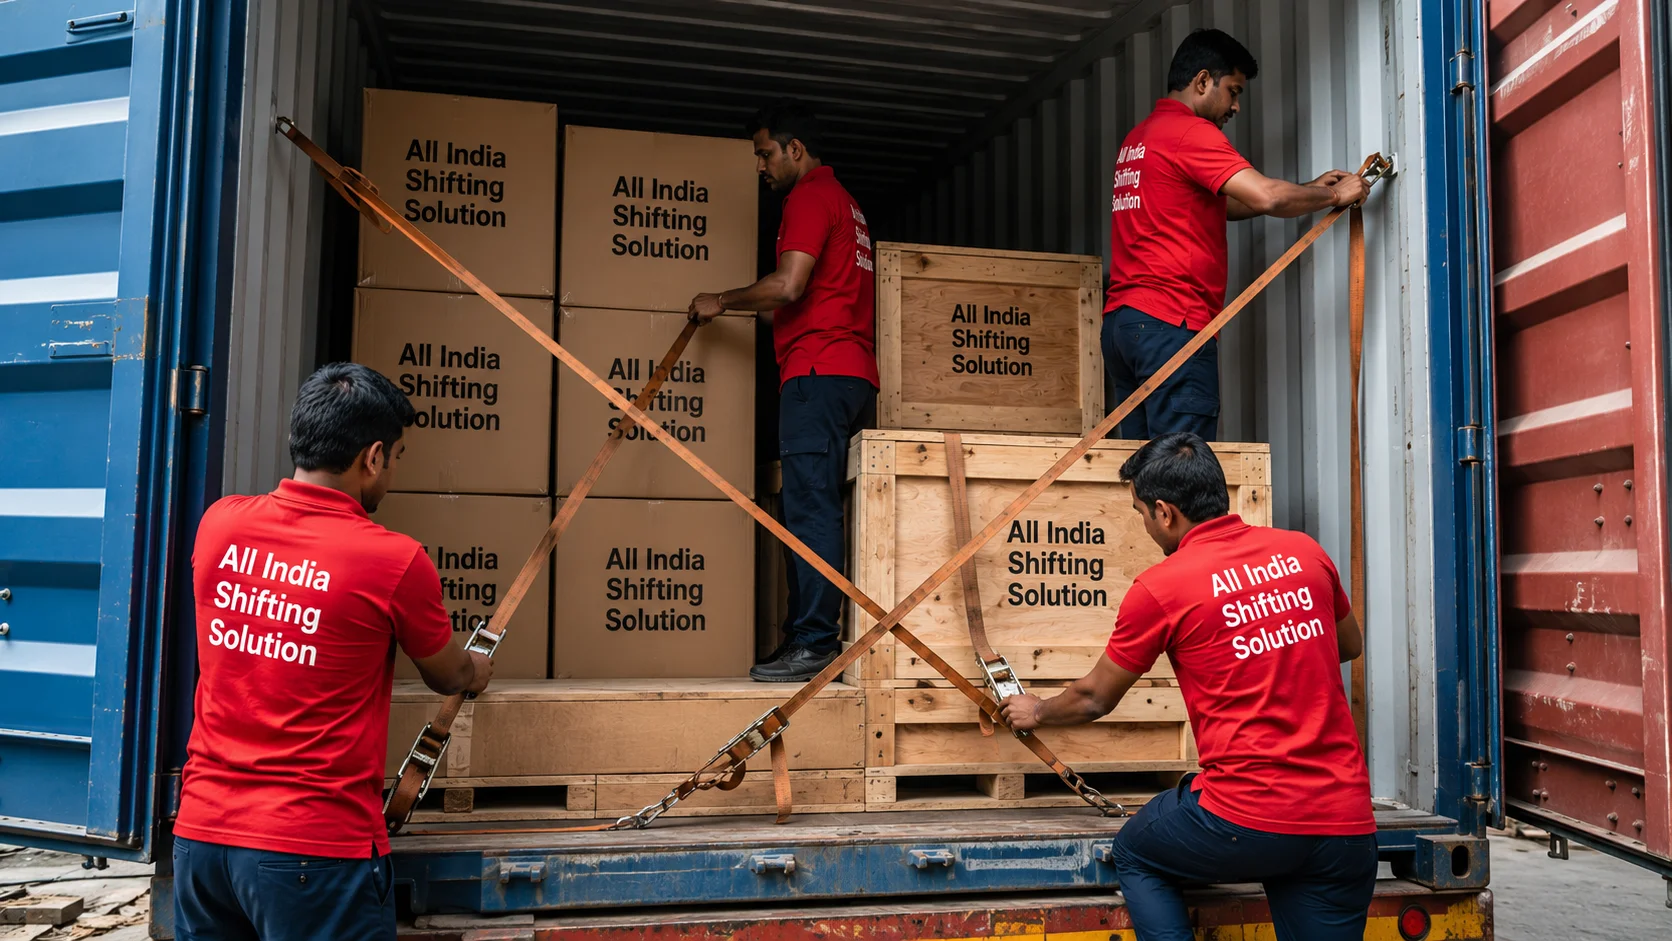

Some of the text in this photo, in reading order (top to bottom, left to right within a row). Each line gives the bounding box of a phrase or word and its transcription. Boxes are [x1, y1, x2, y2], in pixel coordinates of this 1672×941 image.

[405, 139, 506, 168] All India
[405, 168, 504, 203] Shifting
[612, 176, 709, 203] All India
[404, 198, 506, 227] Solution
[613, 204, 707, 237] Shifting
[611, 233, 709, 261] Solution
[951, 304, 1031, 326] All India
[952, 328, 1030, 355] Shifting
[398, 342, 500, 370] All India
[952, 354, 1033, 376] Solution
[608, 358, 705, 383] All Idia
[399, 373, 498, 406] Shifting
[414, 405, 500, 431] olution
[1006, 519, 1105, 544] All India
[218, 544, 331, 592] All India
[437, 546, 499, 570] India
[605, 547, 705, 571] All India
[1007, 550, 1104, 581] Shifting
[1211, 553, 1303, 598] All India
[606, 577, 703, 606] Shifting
[1007, 582, 1107, 607] Solution
[213, 580, 322, 635] Shifting
[605, 608, 706, 631] Solution
[1222, 586, 1314, 628] Shifting
[208, 618, 317, 667] Solution
[1232, 618, 1325, 660] Solution
